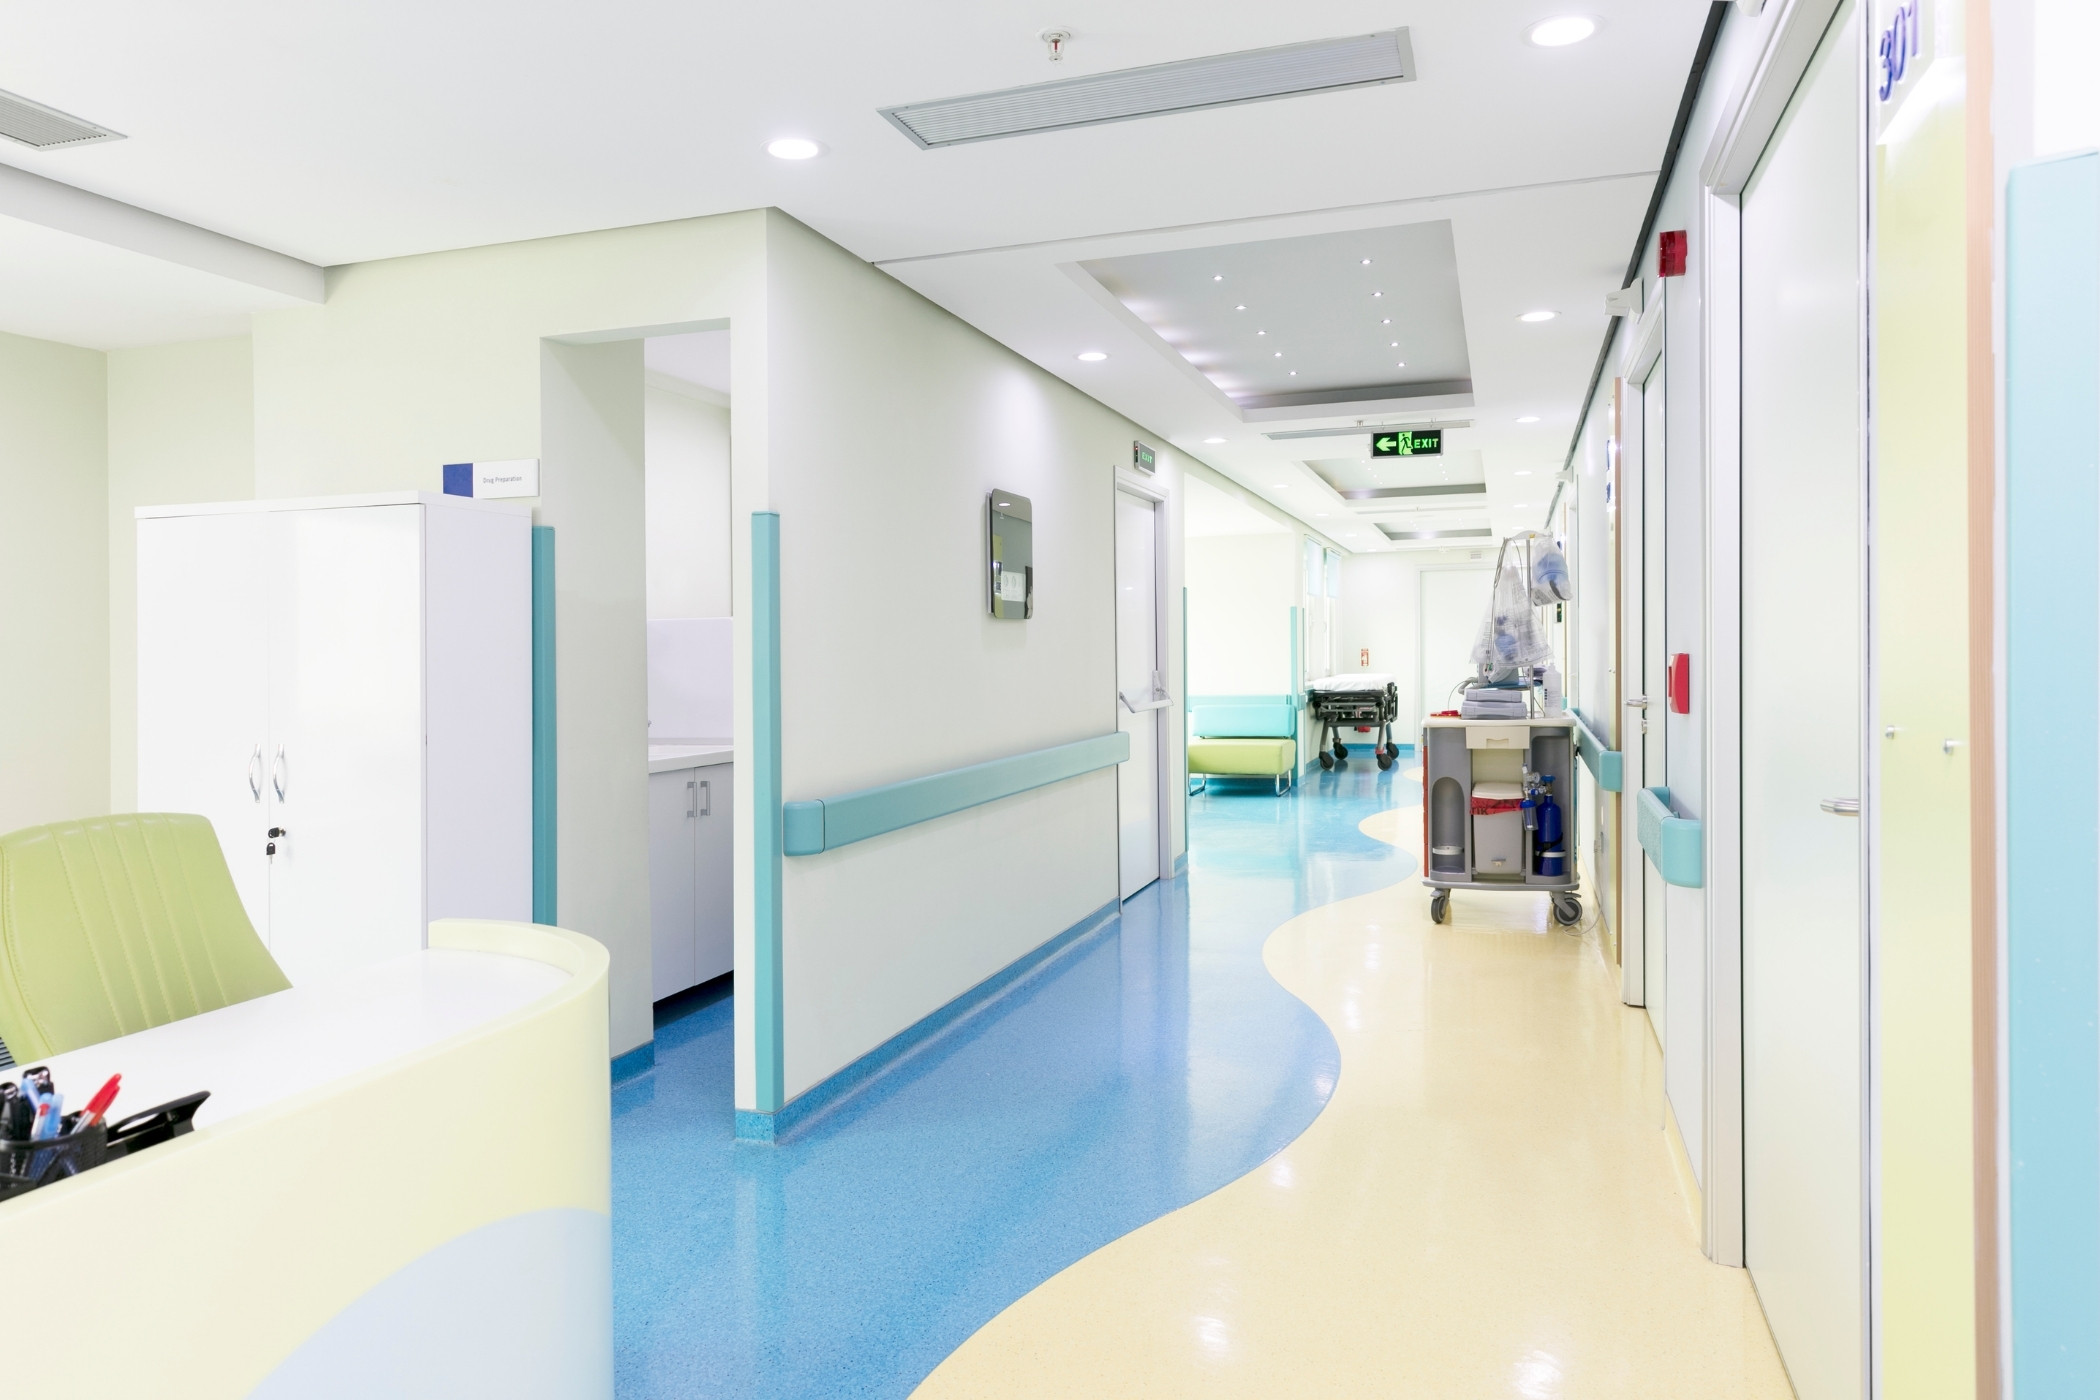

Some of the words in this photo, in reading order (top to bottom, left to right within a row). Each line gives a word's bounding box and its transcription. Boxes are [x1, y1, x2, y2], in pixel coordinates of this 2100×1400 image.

[1879, 0, 1918, 101] 301
[1414, 438, 1439, 448] EXIT
[1142, 452, 1153, 464] EXIT
